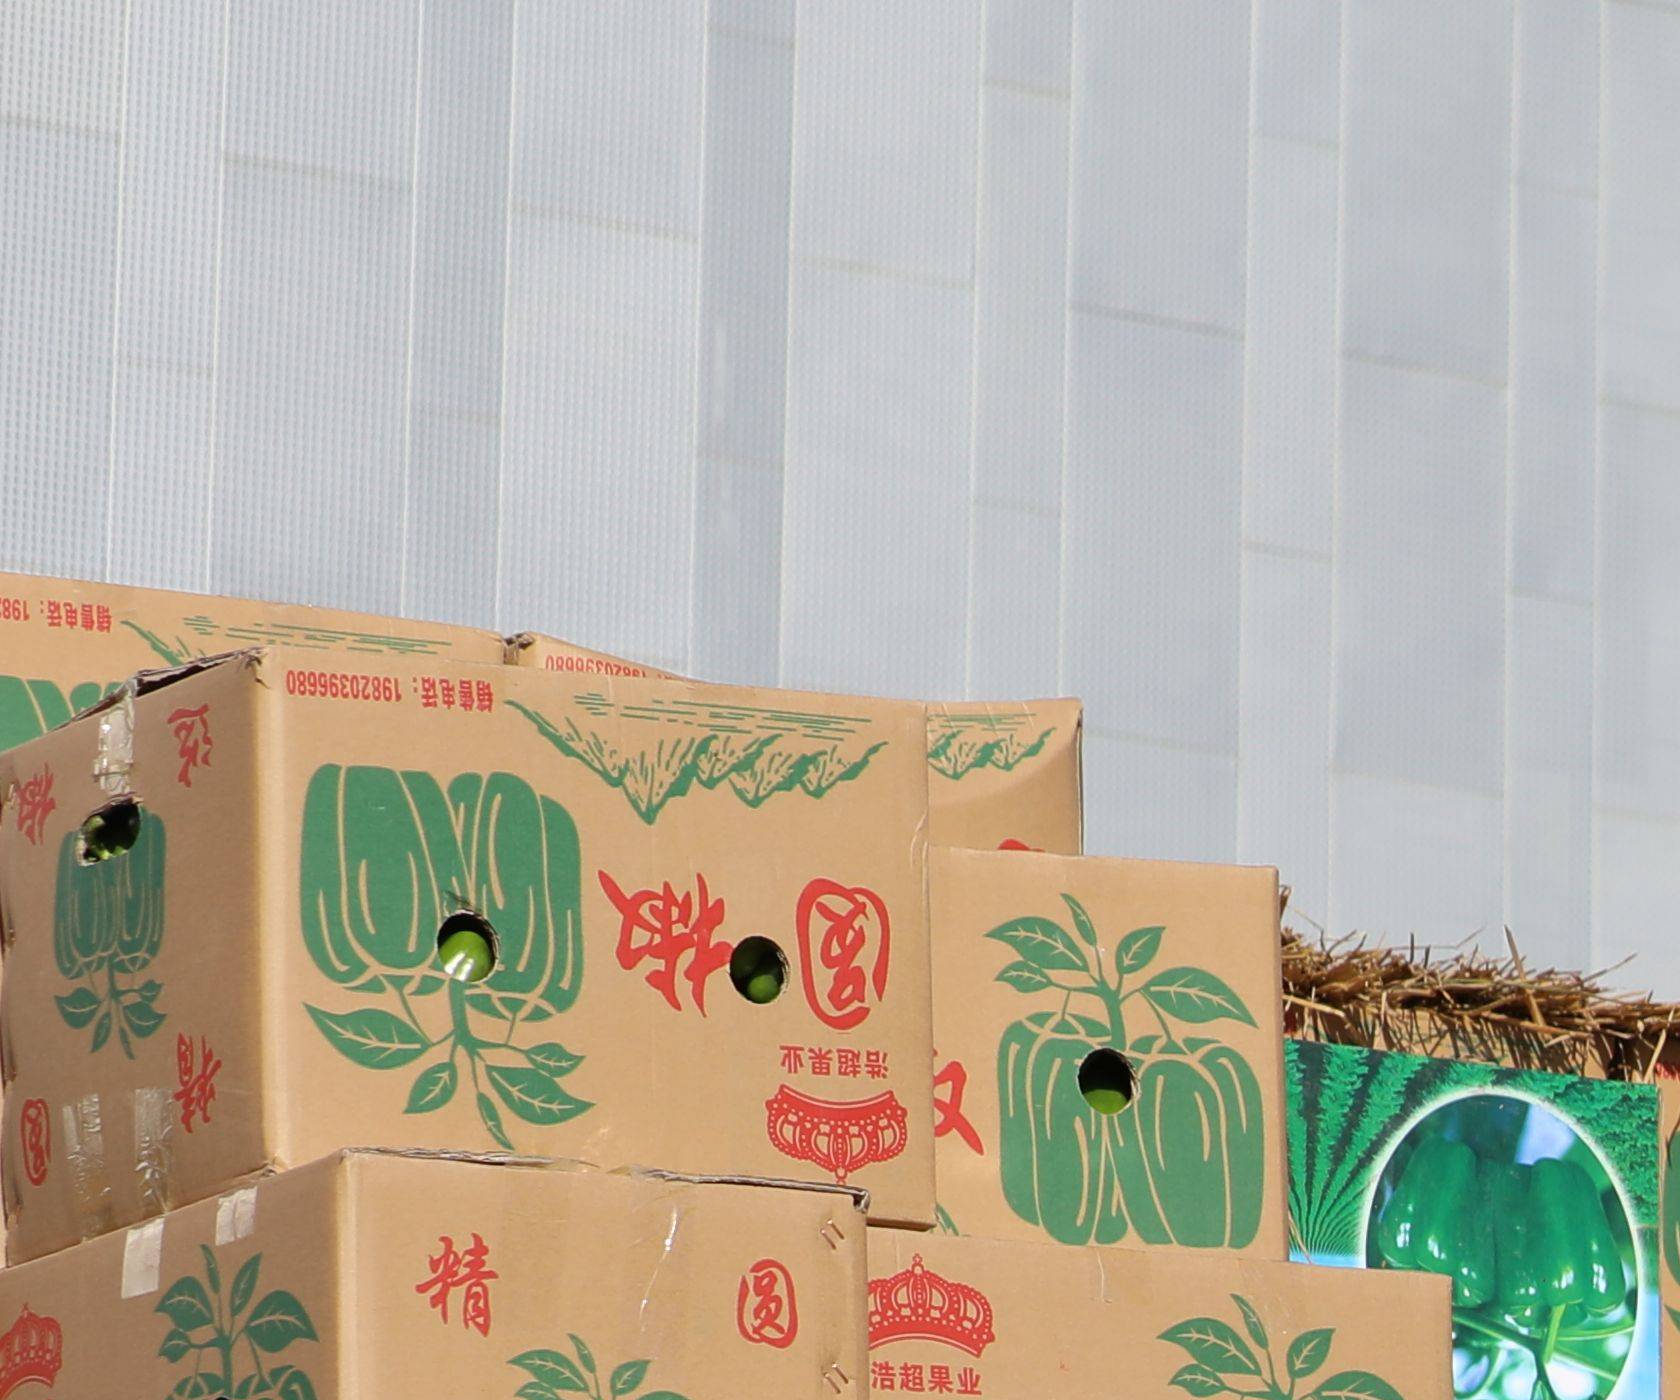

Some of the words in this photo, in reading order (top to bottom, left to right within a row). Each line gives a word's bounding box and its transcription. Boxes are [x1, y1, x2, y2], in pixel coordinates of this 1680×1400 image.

[168, 705, 212, 787] 选
[16, 774, 55, 842] 椒
[598, 871, 890, 1030] 圆椒
[174, 1033, 222, 1133] 精
[781, 1046, 887, 1078] 浩超果业
[20, 1099, 50, 1186] 圆
[416, 1233, 497, 1336] 精
[737, 1259, 798, 1348] 圆
[872, 1362, 981, 1395] 浩超果业
